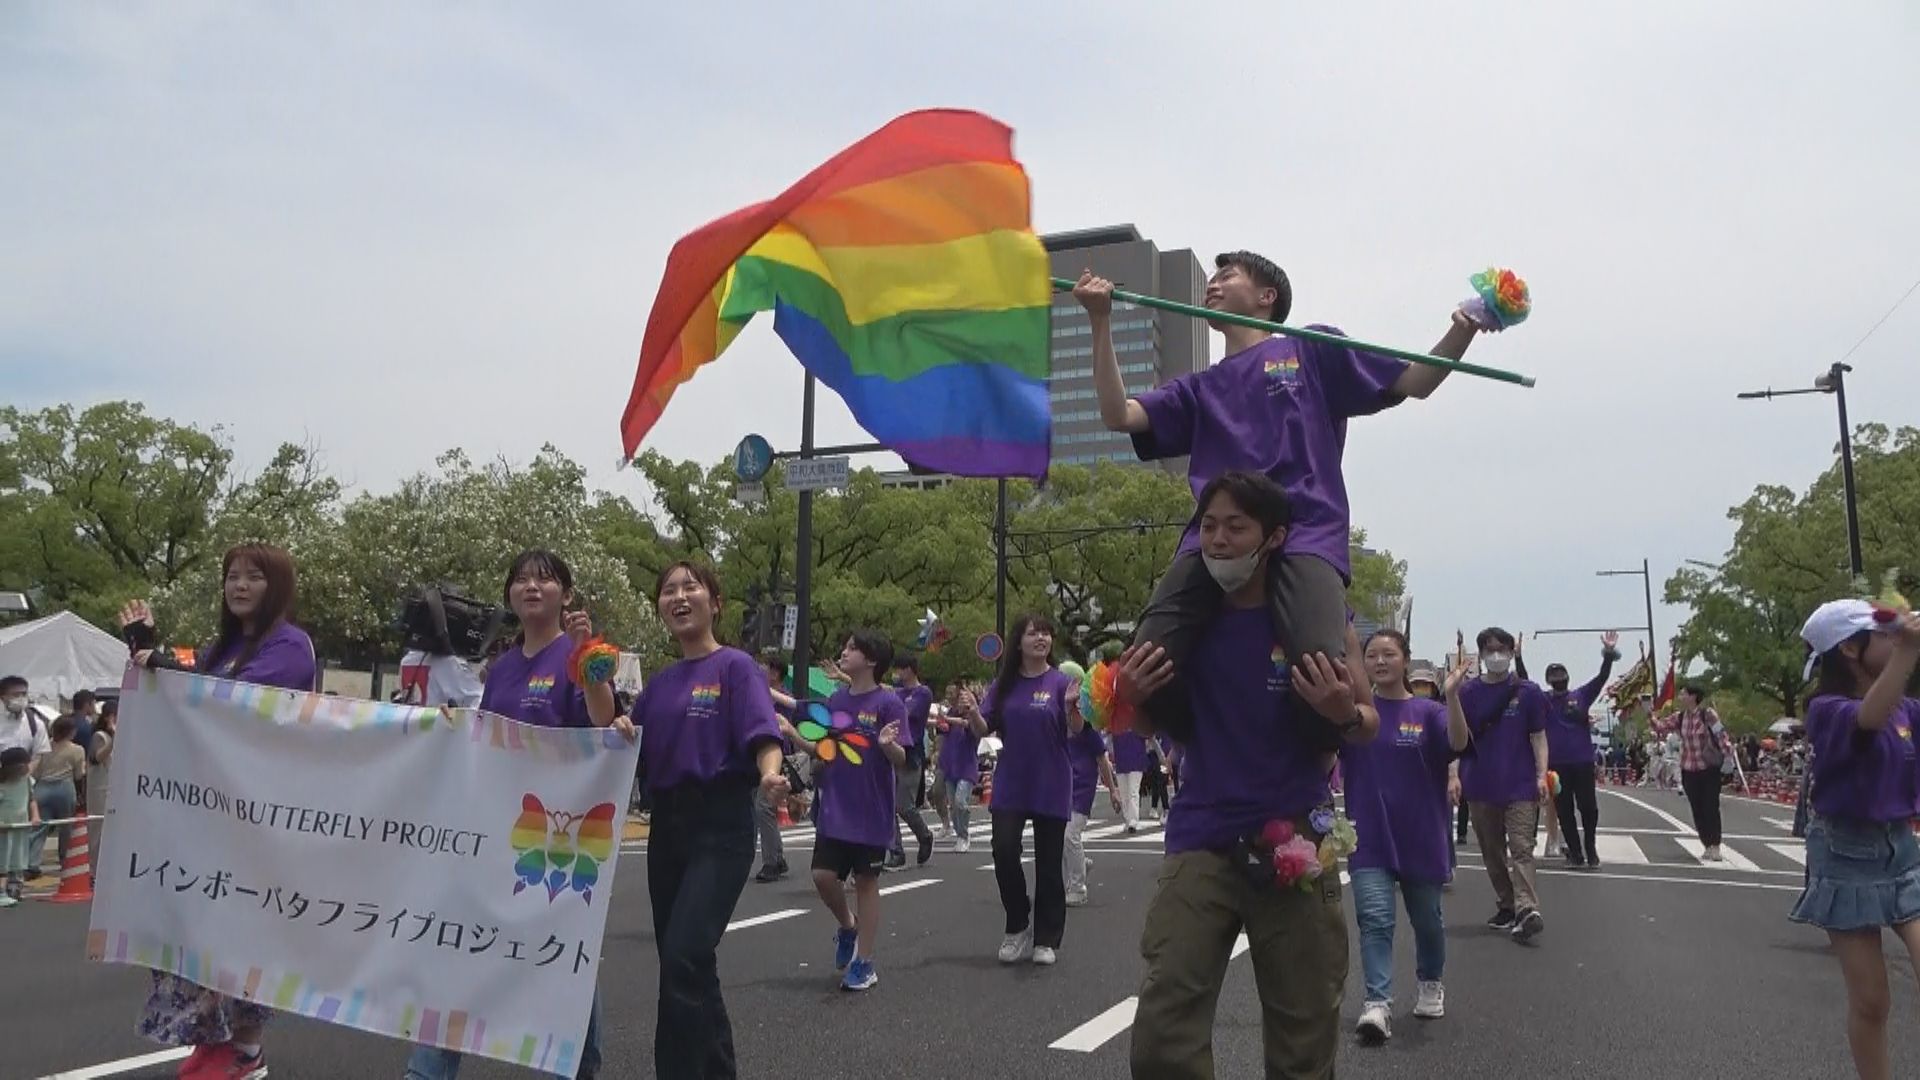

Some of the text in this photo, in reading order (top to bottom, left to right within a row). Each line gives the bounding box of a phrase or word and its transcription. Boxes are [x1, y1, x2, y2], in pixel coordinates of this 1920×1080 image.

[136, 774, 488, 857] RAINBOW BUTTERFLY PROJECT
[129, 852, 590, 974] レインボーバタフライプロジェクト
